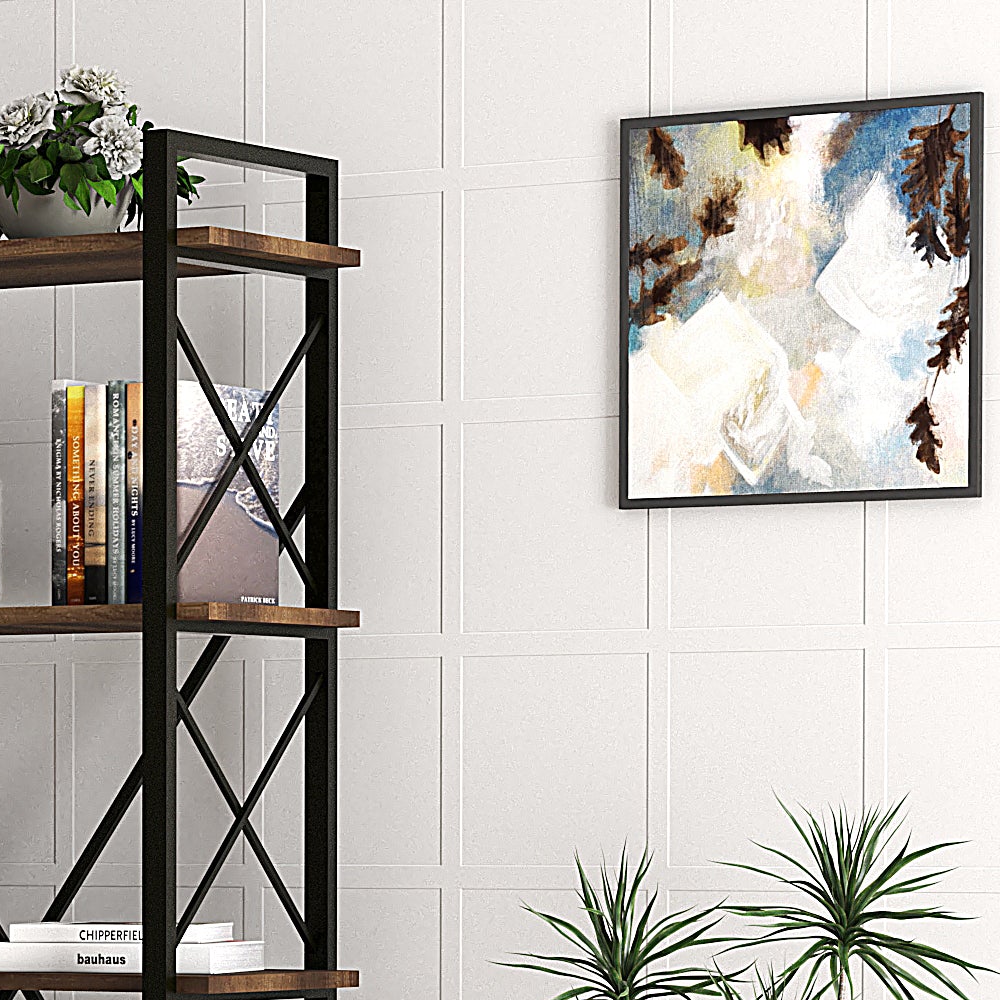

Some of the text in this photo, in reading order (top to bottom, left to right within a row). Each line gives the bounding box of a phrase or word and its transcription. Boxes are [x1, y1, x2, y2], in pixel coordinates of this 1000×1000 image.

[131, 426, 139, 449] DAY
[72, 435, 81, 566] SOMETHING ABOUT YOU
[88, 459, 96, 537] NEVER ENDING
[112, 464, 120, 504] SUMMER
[131, 477, 139, 517] NIGHTS
[112, 506, 120, 554] HOLIDAYS
[79, 930, 143, 941] CHIPPERFIEL
[77, 953, 126, 965] bauhaus
